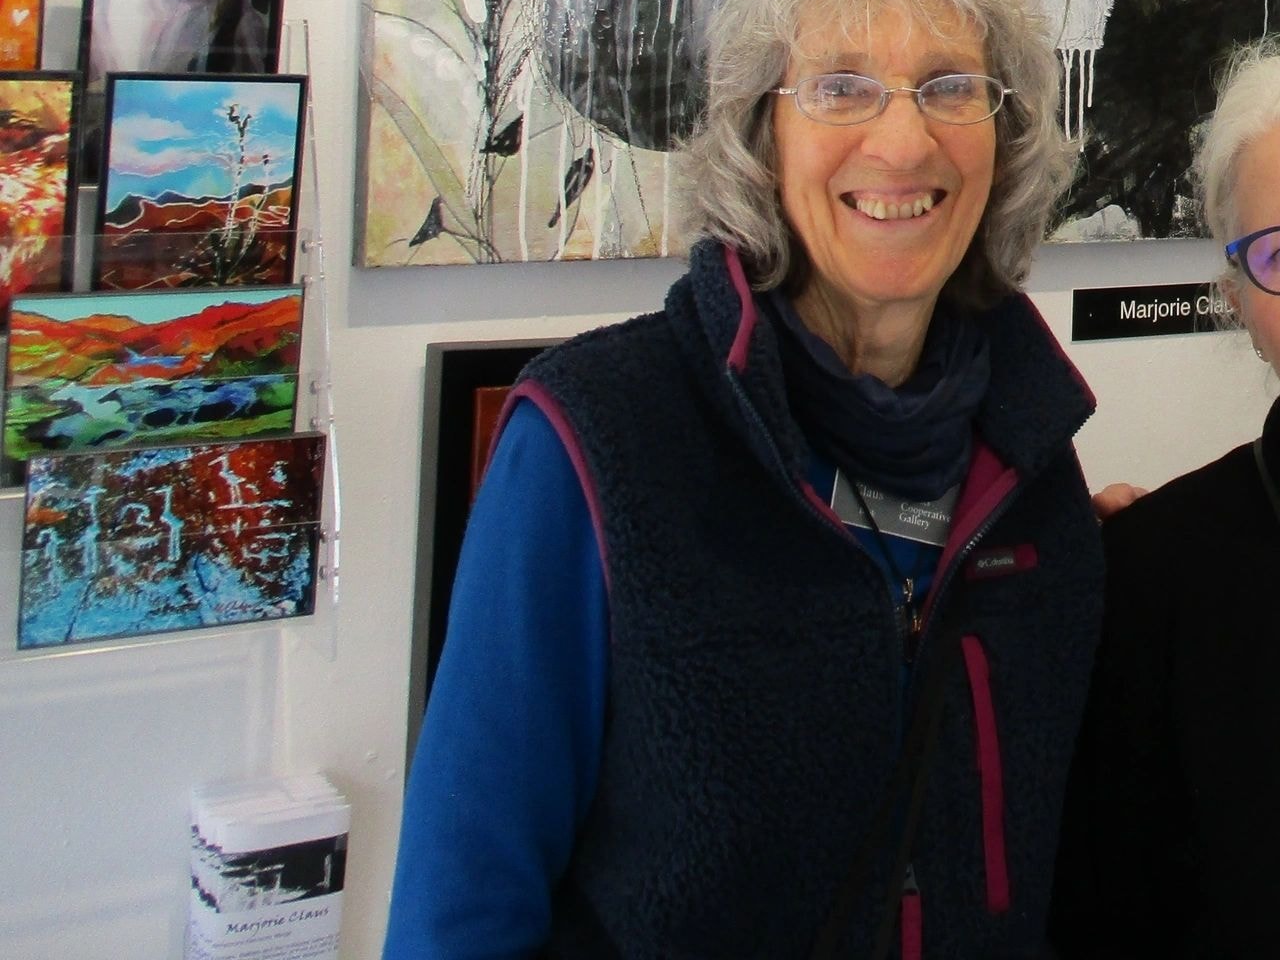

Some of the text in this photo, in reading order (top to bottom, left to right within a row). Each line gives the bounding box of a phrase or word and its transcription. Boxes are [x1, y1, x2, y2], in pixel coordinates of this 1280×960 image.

[1120, 295, 1235, 322] Marjorie Clau
[899, 513, 930, 530] Gallery
[900, 502, 951, 523] Cooperative
[225, 915, 286, 937] Marjorie
